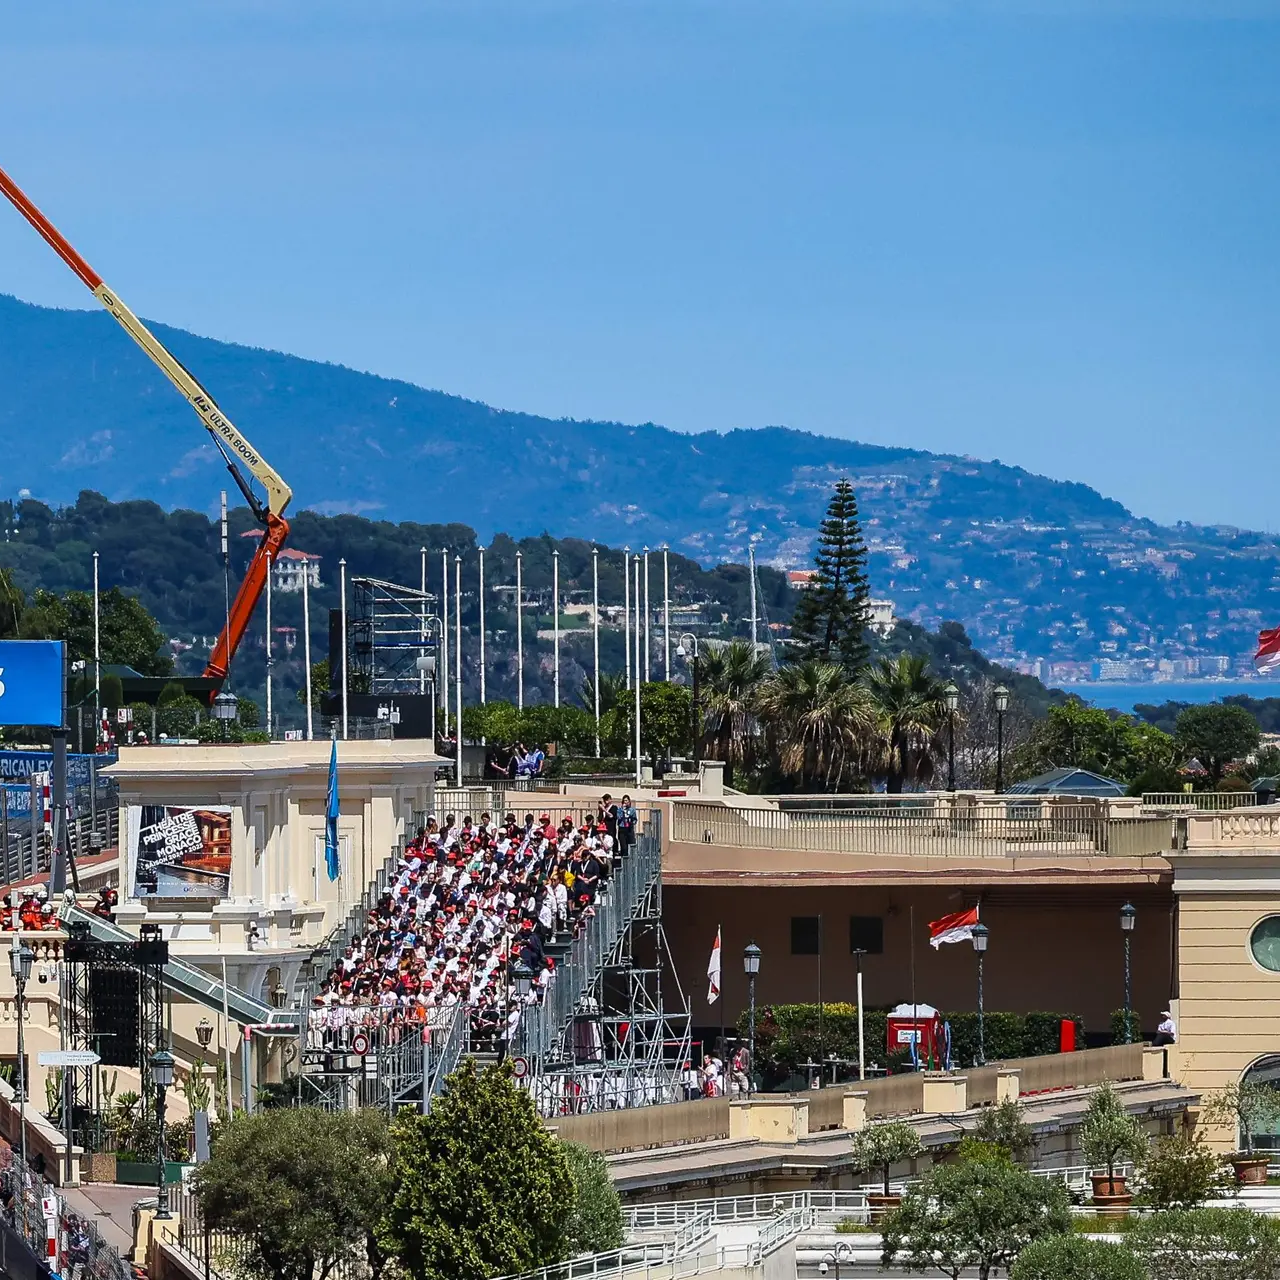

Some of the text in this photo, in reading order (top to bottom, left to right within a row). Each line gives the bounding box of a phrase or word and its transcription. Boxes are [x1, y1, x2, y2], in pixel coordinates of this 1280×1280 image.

[209, 413, 234, 441] ULTRA
[233, 435, 258, 467] BOOM
[143, 819, 197, 845] PRINCESSE
[165, 828, 200, 846] GRACE
[156, 835, 202, 858] MONACO
[145, 857, 168, 870] SAISON
